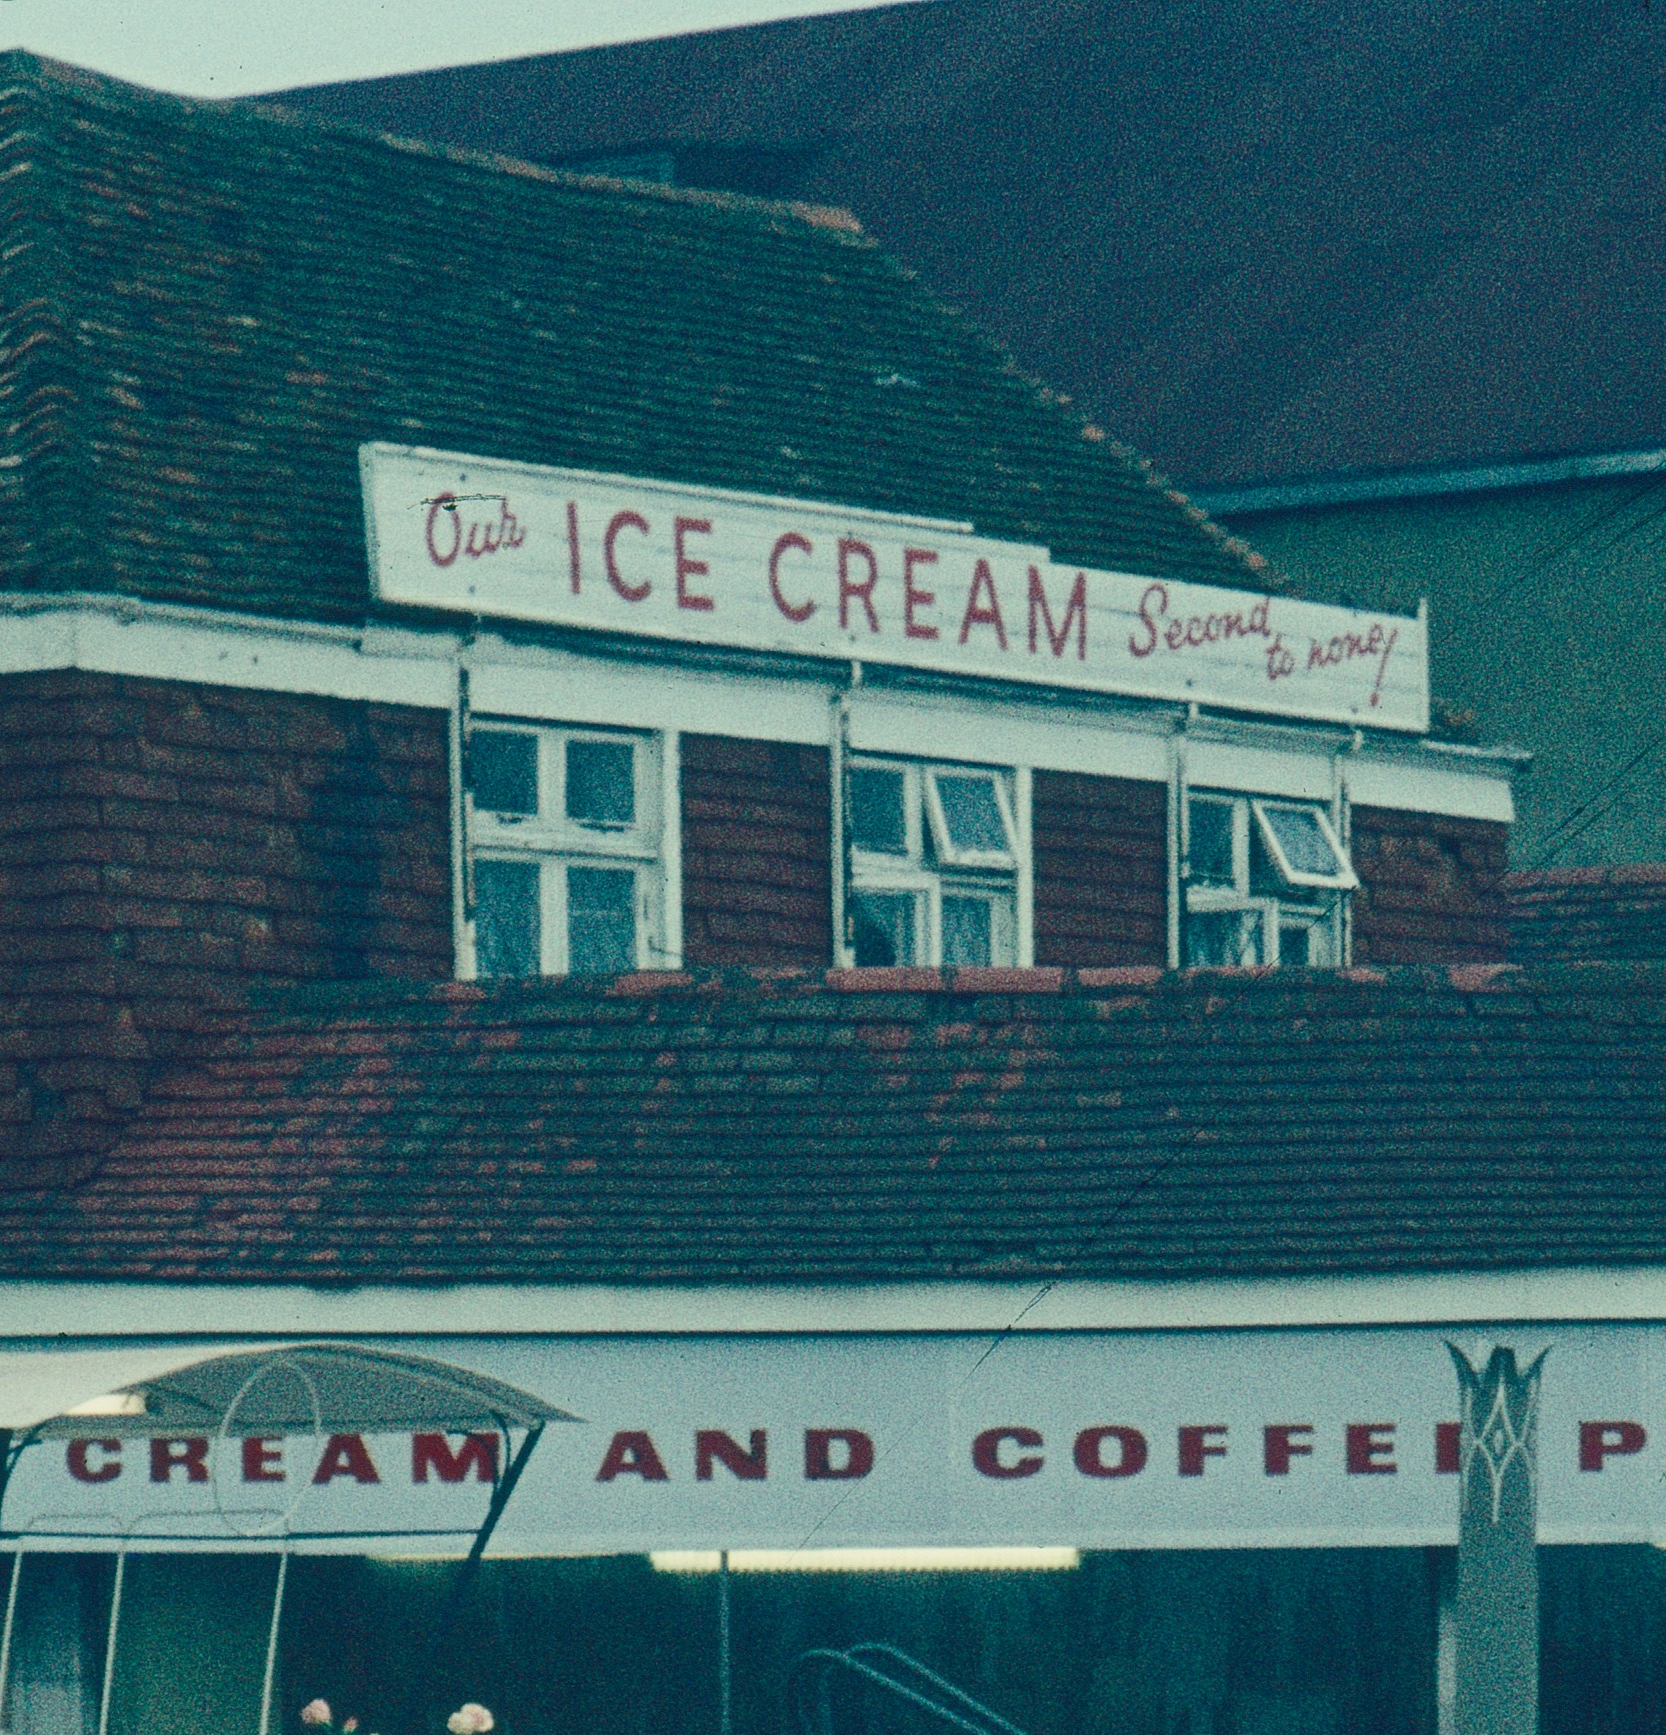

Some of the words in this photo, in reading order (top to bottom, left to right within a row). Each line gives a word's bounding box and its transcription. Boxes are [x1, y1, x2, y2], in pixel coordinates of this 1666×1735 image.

[426, 490, 528, 567] Our
[564, 500, 715, 612] ICE
[767, 532, 1089, 661] CREAM
[1128, 583, 1271, 658] Second
[1266, 632, 1296, 680] to
[66, 1432, 500, 1485] CREAM
[595, 1427, 876, 1483] AND
